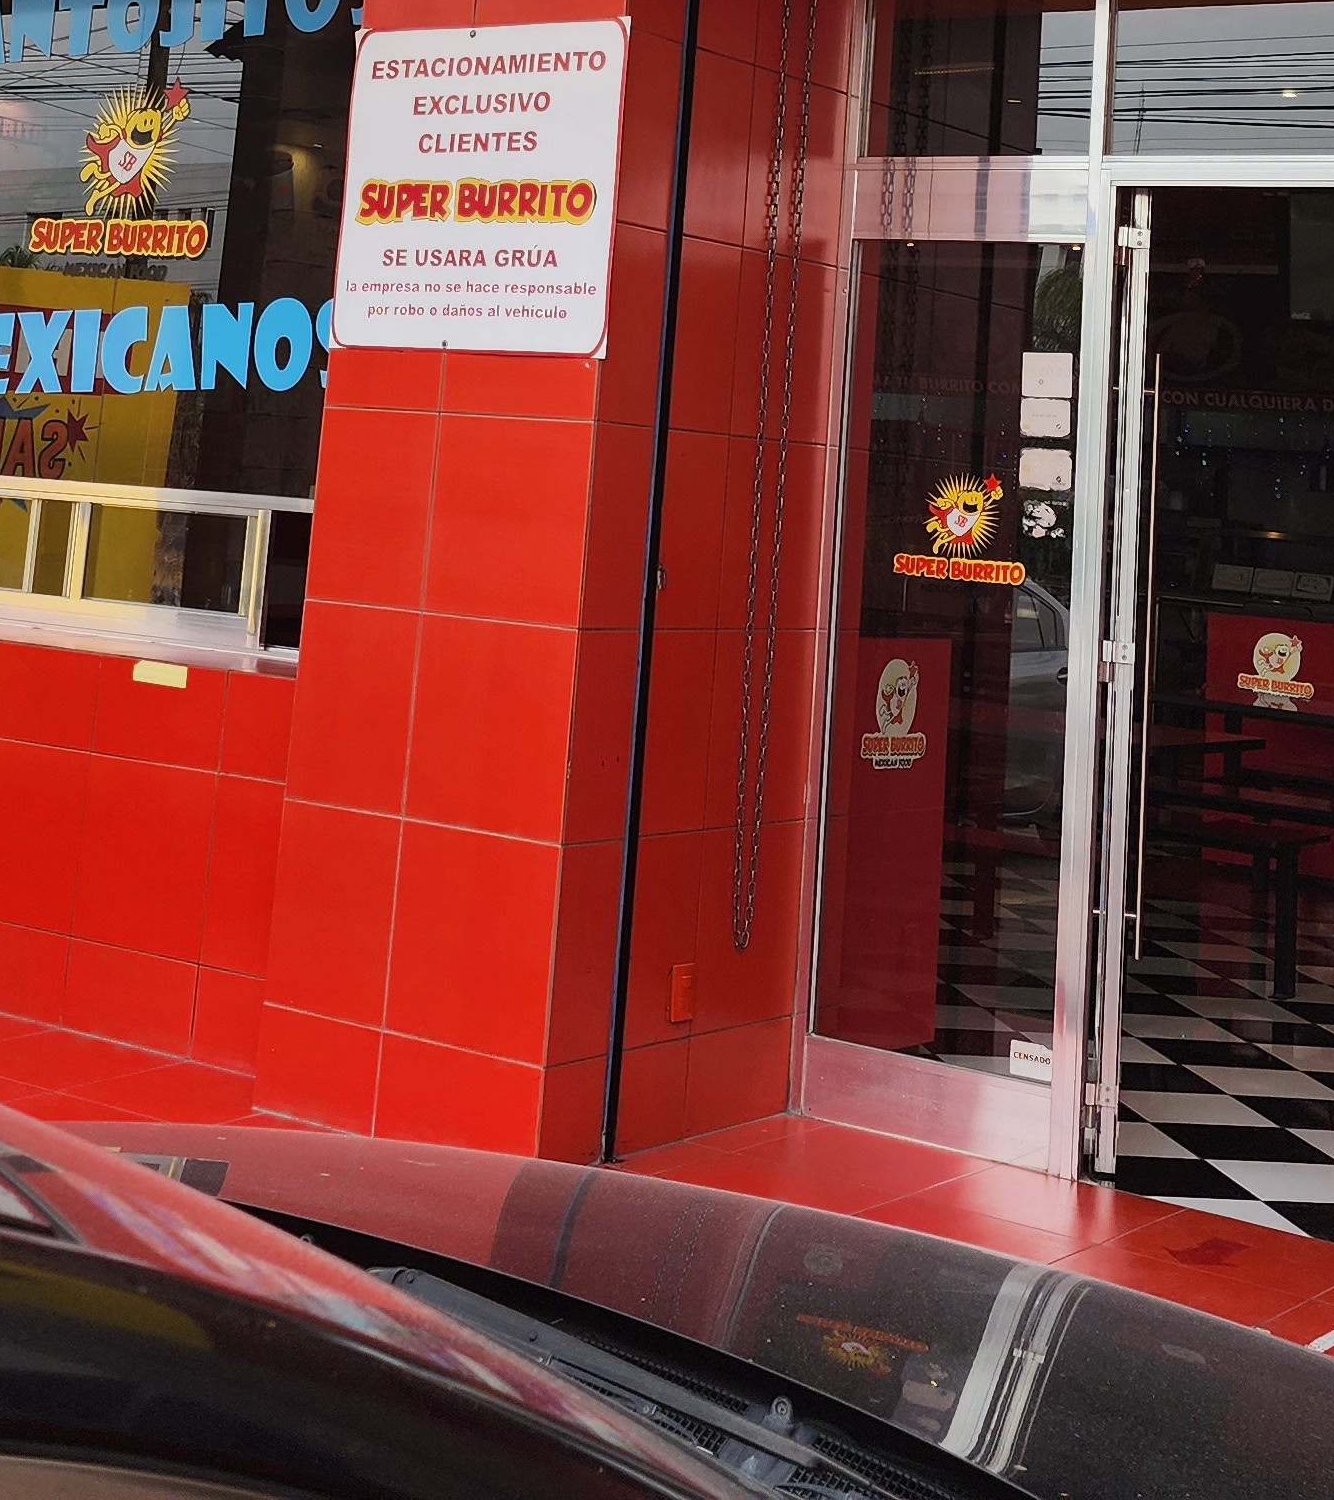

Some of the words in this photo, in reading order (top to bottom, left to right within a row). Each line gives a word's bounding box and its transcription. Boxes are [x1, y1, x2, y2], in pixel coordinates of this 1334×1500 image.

[371, 50, 607, 80] ESTACIONAMIENTO
[413, 91, 551, 116] EXCLUSIVO
[418, 131, 538, 154] CLIENTES
[359, 182, 451, 219] SUPER
[455, 182, 593, 219] BURRITO
[30, 220, 103, 251] SUPER
[105, 222, 206, 256] BURRITO
[382, 249, 407, 267] SE
[415, 249, 487, 267] USARA
[494, 245, 558, 268] GRÚA
[345, 280, 357, 292] la
[361, 282, 420, 296] empresa
[424, 282, 441, 293] no
[446, 282, 461, 293] se
[466, 280, 500, 293] hace
[505, 281, 597, 296] responsable
[367, 305, 389, 318] por
[393, 304, 425, 316] robo
[429, 307, 437, 316] o
[442, 304, 484, 317] daños
[487, 304, 501, 317] al
[504, 305, 567, 320] vehículo
[1161, 390, 1199, 406] CON
[1205, 392, 1316, 412] CUALQUIERA
[894, 554, 947, 579] SUPER
[950, 560, 1024, 584] BURRITO
[1239, 674, 1270, 690] SUPER
[1271, 679, 1312, 696] BURRITO
[862, 736, 889, 754] SUPER
[890, 736, 925, 754] BURRITO
[1014, 1052, 1051, 1065] CENSADO
